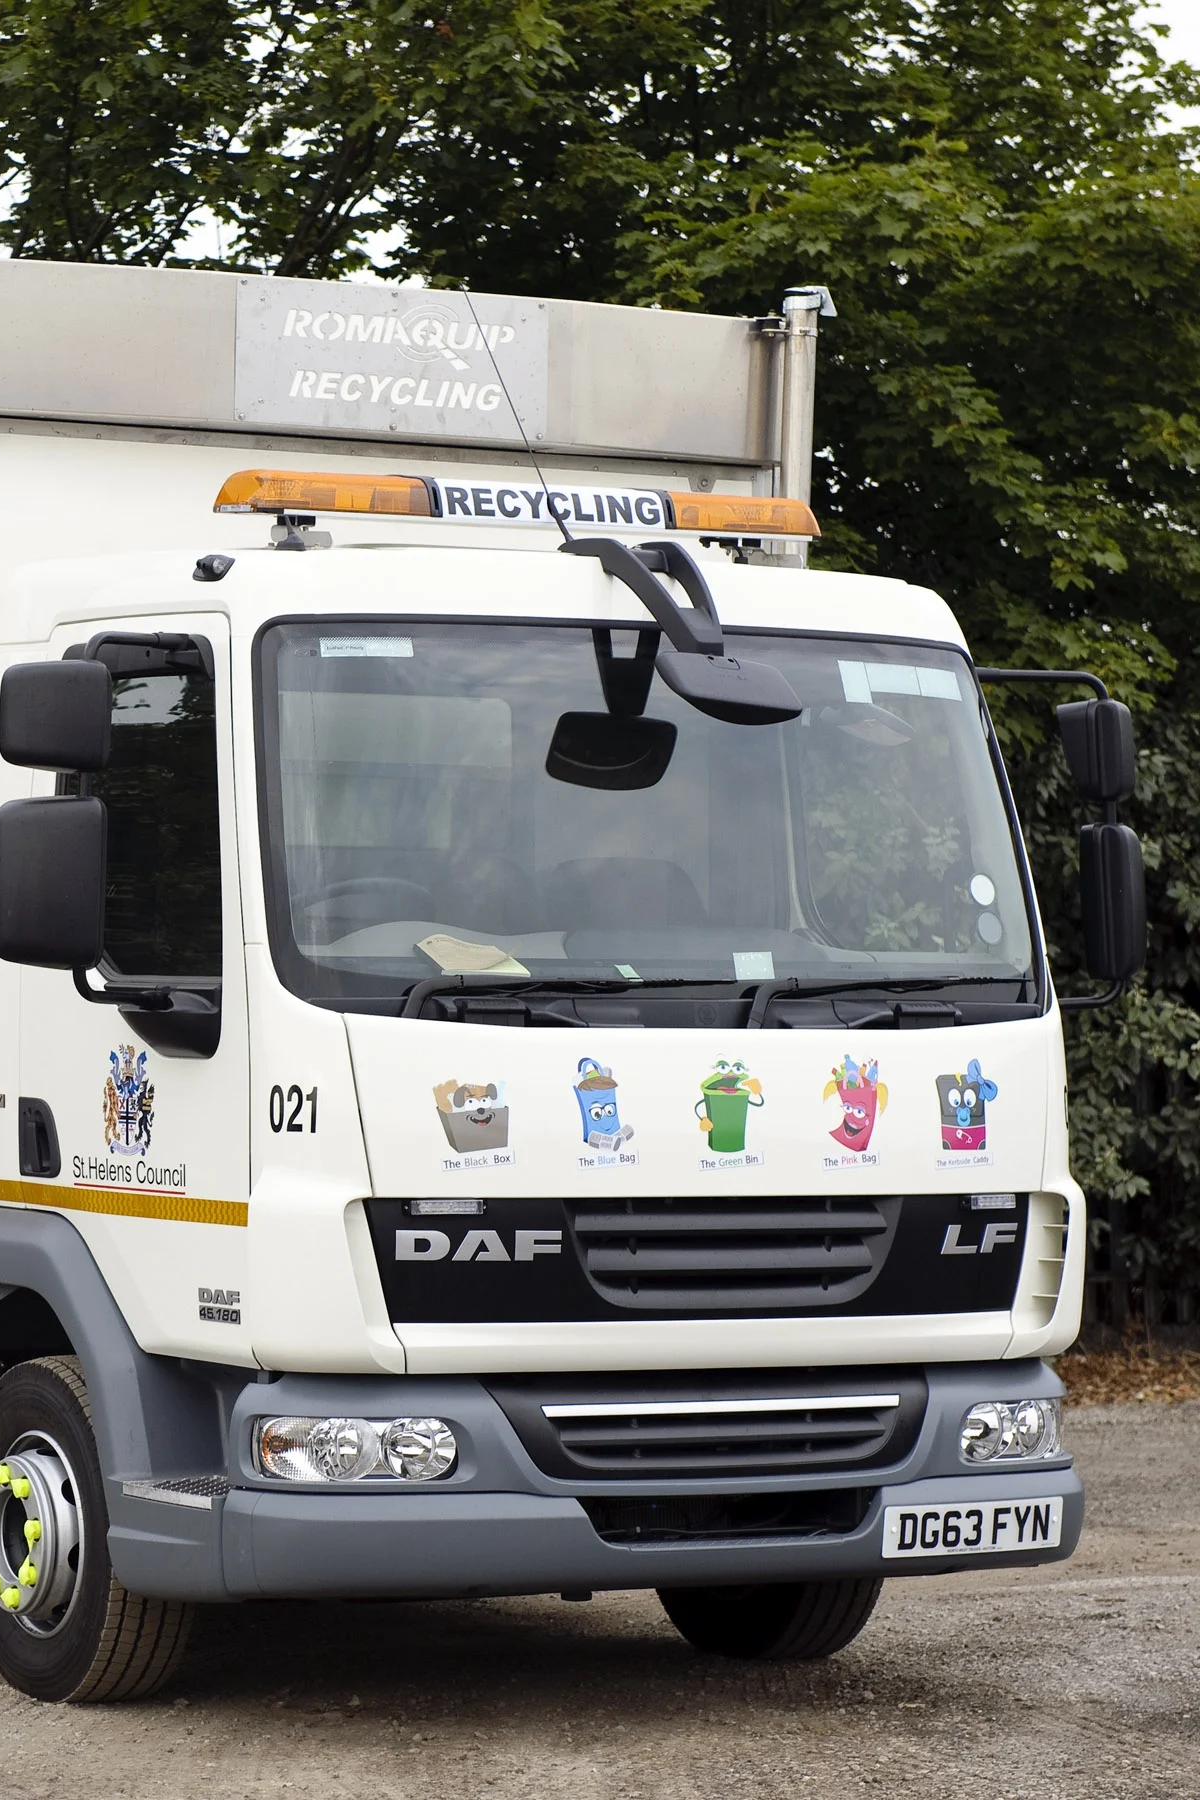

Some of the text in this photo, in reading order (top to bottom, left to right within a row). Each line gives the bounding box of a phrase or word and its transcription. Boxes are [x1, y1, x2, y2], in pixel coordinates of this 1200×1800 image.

[289, 369, 503, 411] RECYCLING
[444, 486, 661, 525] RECYCLING
[269, 1084, 318, 1134] 021
[136, 1160, 186, 1187] Council
[443, 1153, 511, 1169] The Black Box
[578, 1153, 636, 1167] The Blue Bag
[700, 1155, 759, 1169] The Green Bin
[823, 1153, 877, 1167] The Pink Bag
[395, 1229, 563, 1262] DAF
[940, 1222, 1018, 1255] LF
[198, 1287, 240, 1306] DAF
[199, 1307, 239, 1322] 45.180
[897, 1503, 1051, 1550] DG63 FYN
